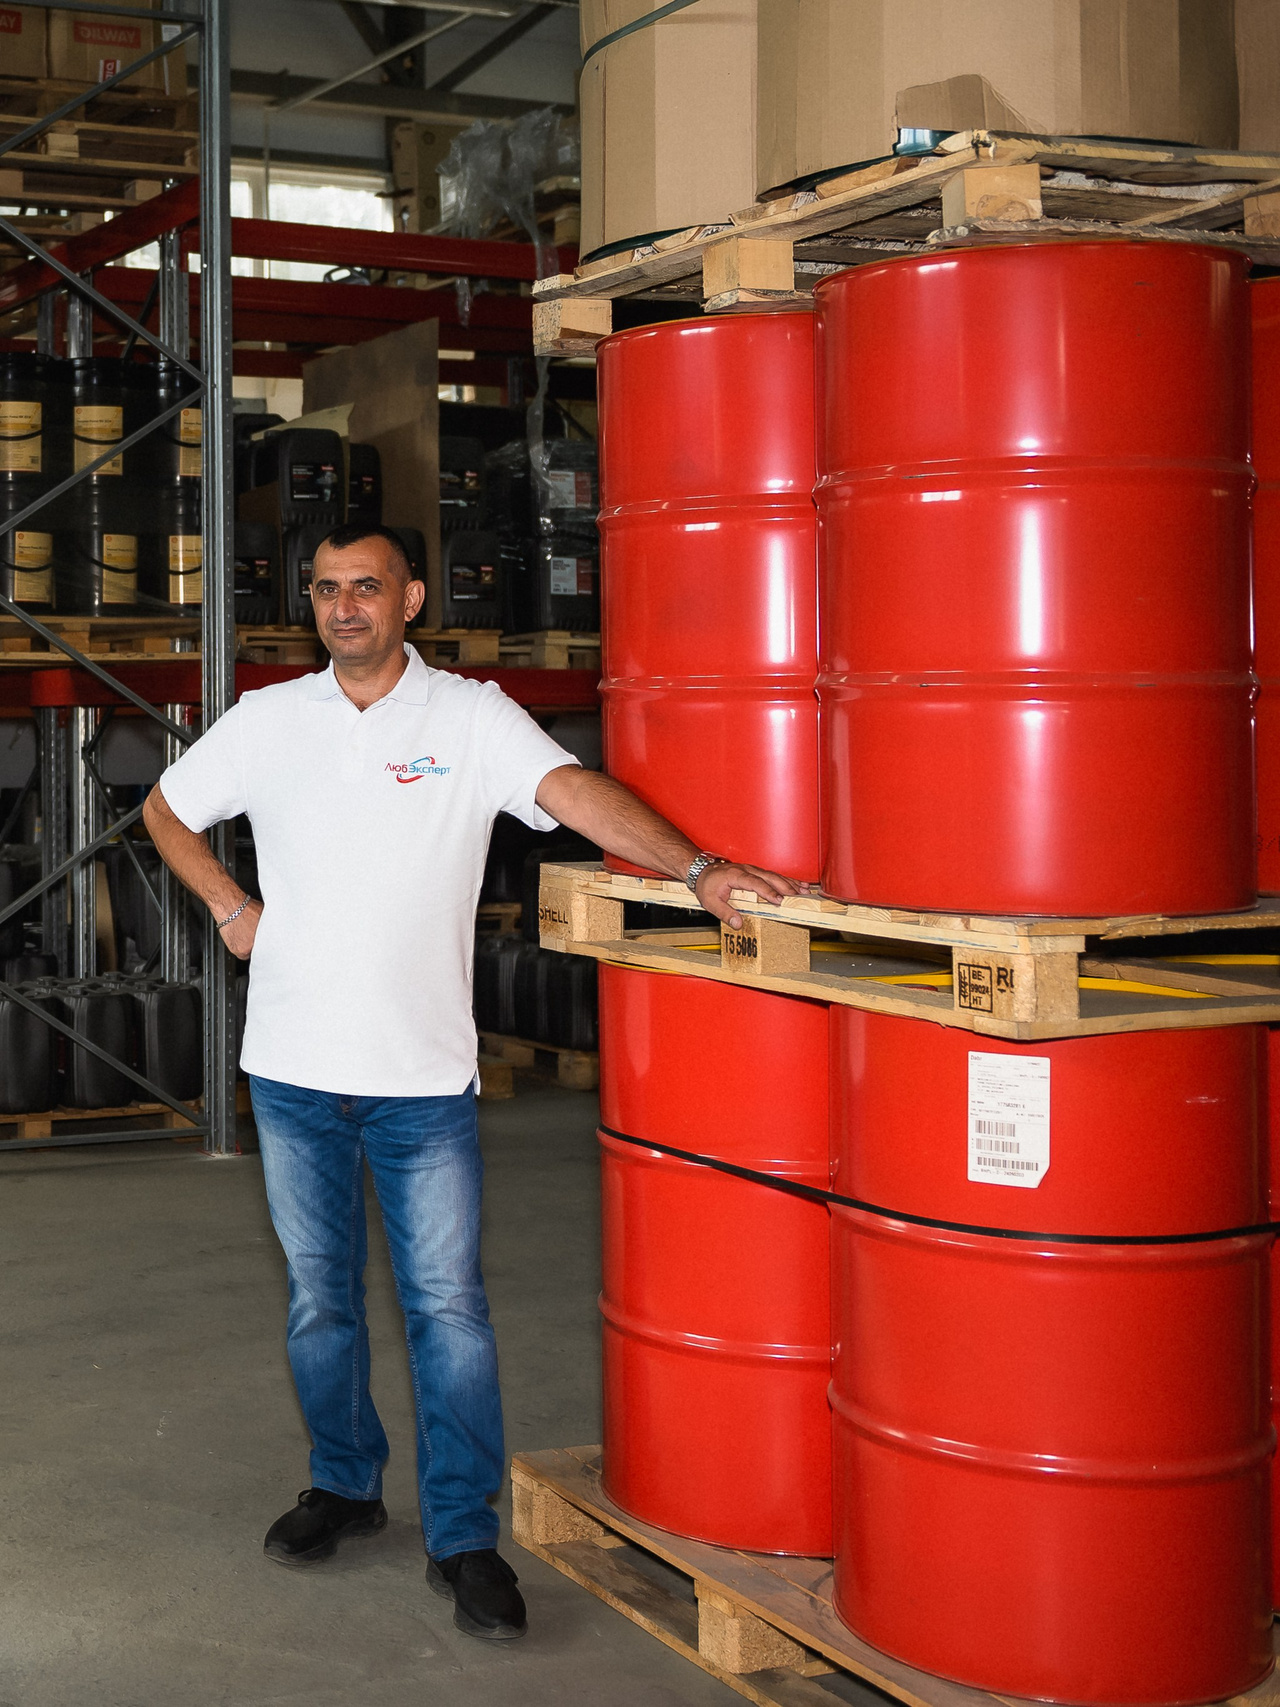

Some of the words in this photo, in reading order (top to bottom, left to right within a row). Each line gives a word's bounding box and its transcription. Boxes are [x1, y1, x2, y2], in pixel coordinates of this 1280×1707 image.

[80, 26, 136, 43] OILWAY
[724, 933, 735, 955] T5
[972, 995, 983, 1006] HT
